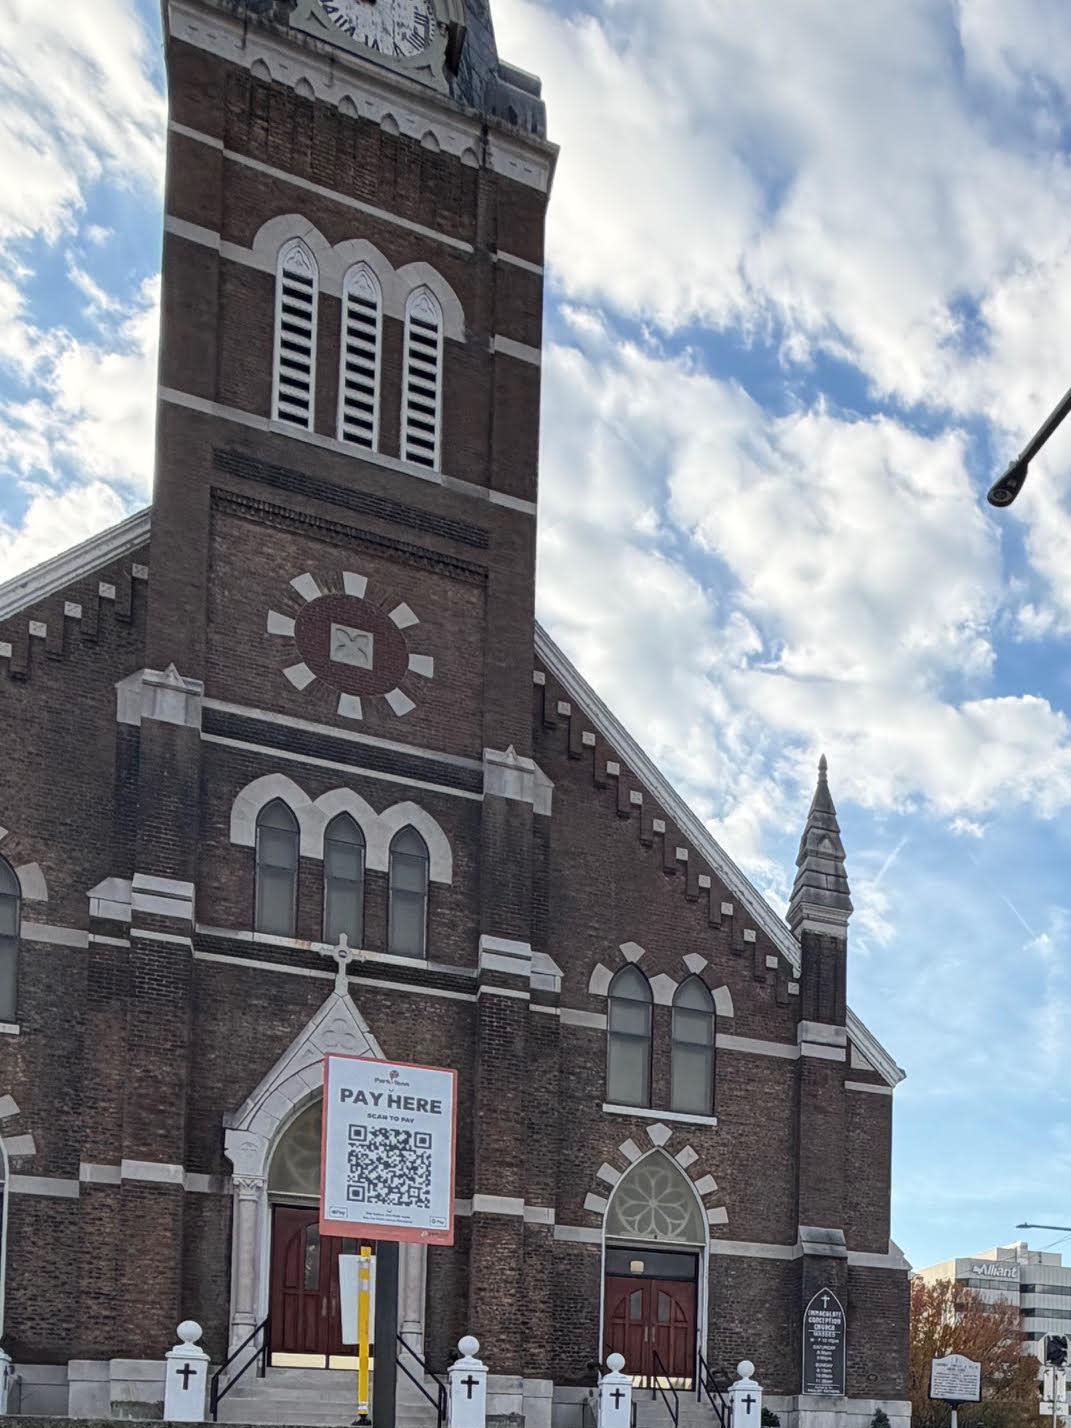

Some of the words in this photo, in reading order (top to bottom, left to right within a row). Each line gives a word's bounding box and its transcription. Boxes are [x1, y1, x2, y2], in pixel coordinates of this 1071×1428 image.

[340, 1087, 383, 1107] PAY
[387, 1094, 442, 1114] HERE
[367, 1112, 388, 1121] SCAN
[401, 1116, 415, 1124] PAY
[980, 1263, 1017, 1279] Alliant
